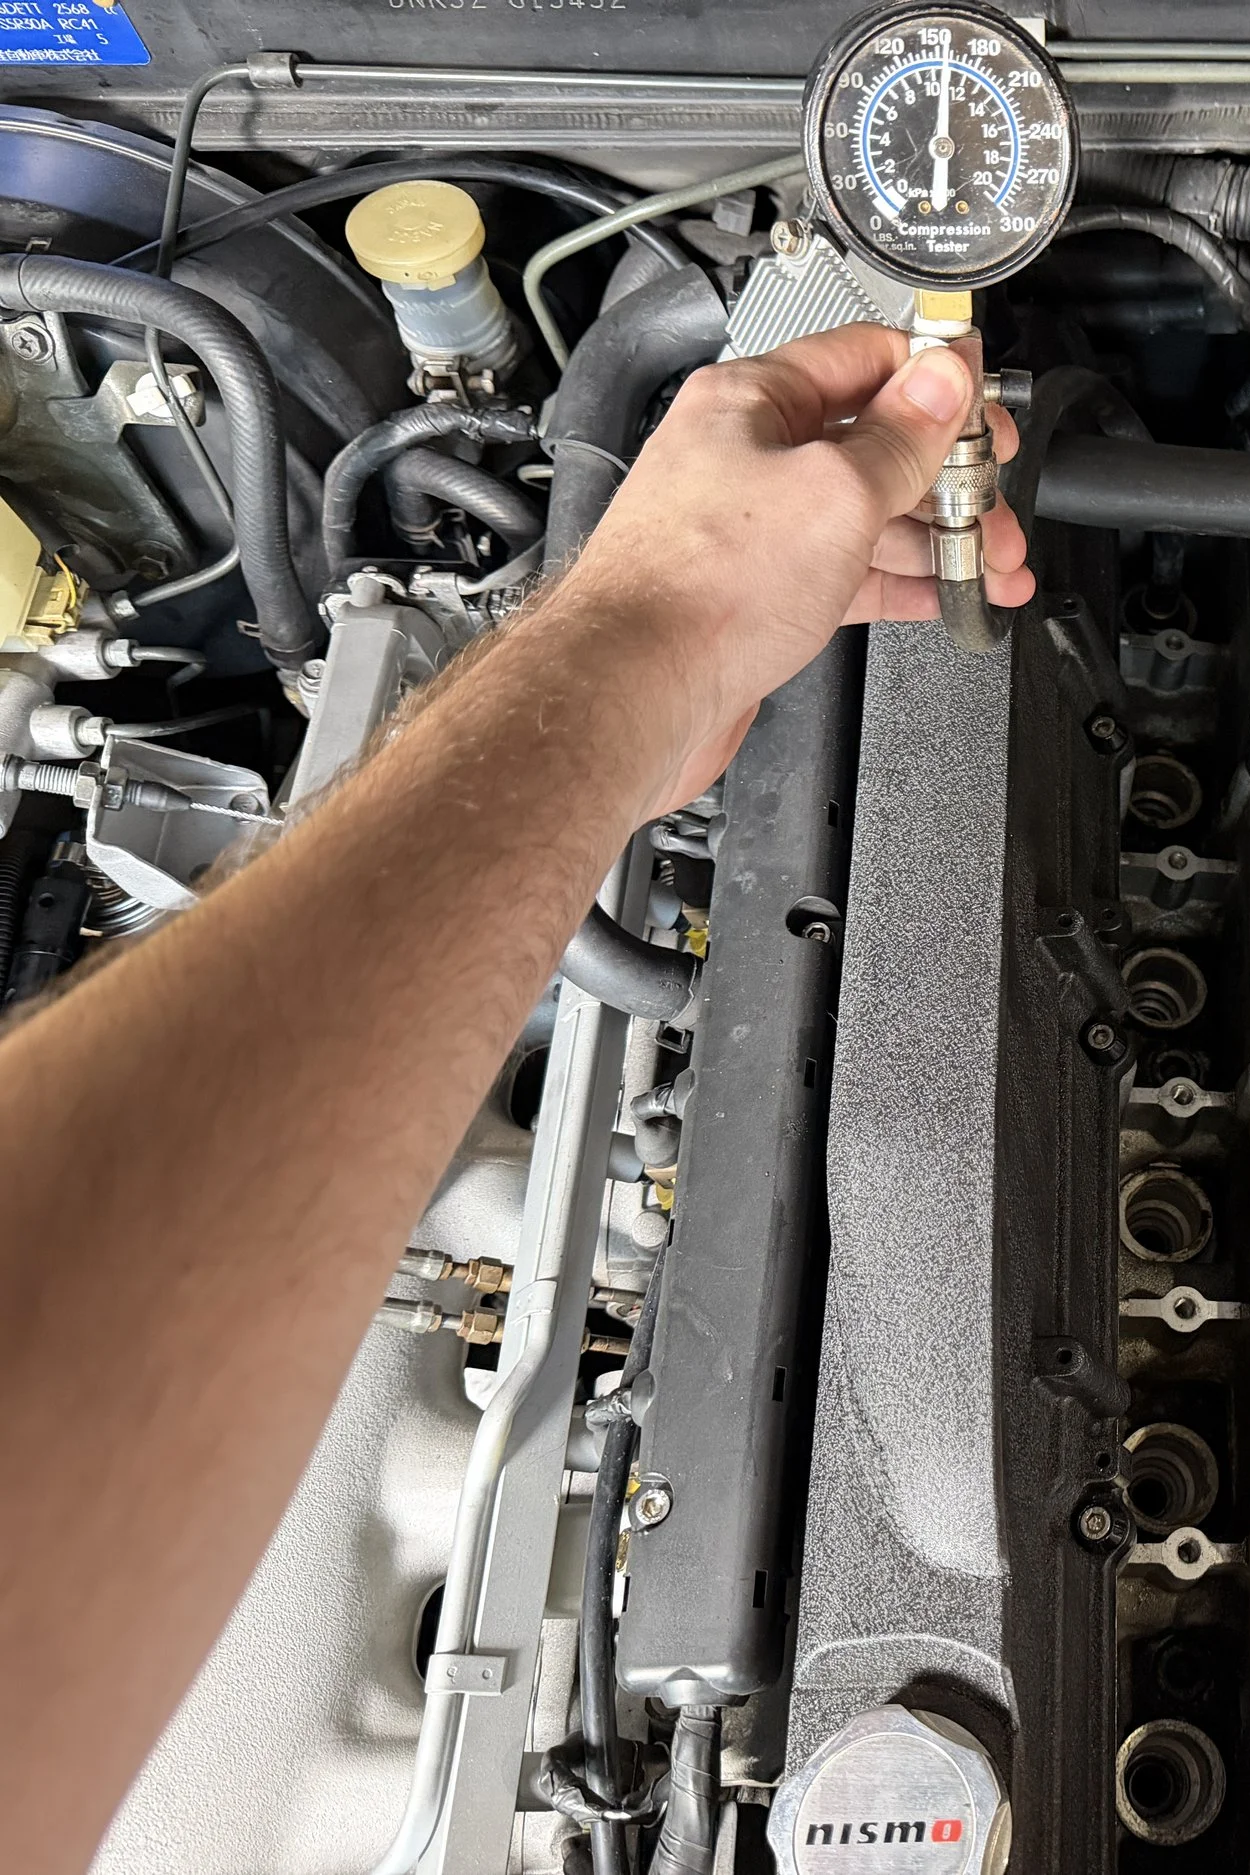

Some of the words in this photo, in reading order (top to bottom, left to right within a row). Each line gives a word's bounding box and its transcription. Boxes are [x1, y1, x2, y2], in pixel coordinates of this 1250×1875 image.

[53, 3, 90, 15] 2568
[57, 18, 98, 30] RC41
[96, 33, 109, 45] 5
[918, 28, 952, 46] 150
[874, 38, 904, 55] 120
[968, 39, 1000, 56] 180
[839, 72, 864, 89] 90
[1008, 71, 1041, 88] 210
[924, 81, 941, 97] 10
[949, 86, 965, 101] 12
[905, 90, 916, 105] 8
[887, 105, 898, 121] 6
[968, 102, 985, 118] 14
[824, 122, 848, 138] 60
[981, 123, 998, 138] 16
[1029, 123, 1062, 139] 240
[879, 132, 891, 147] 4
[984, 150, 1000, 165] 18
[884, 159, 896, 174] 2
[832, 174, 856, 191] 30
[973, 171, 993, 186] 20
[1027, 168, 1059, 185] 270
[896, 178, 908, 193] 0
[870, 215, 882, 231] 0
[898, 221, 991, 239] Compression
[1000, 216, 1036, 232] 300
[926, 239, 970, 253] Tester
